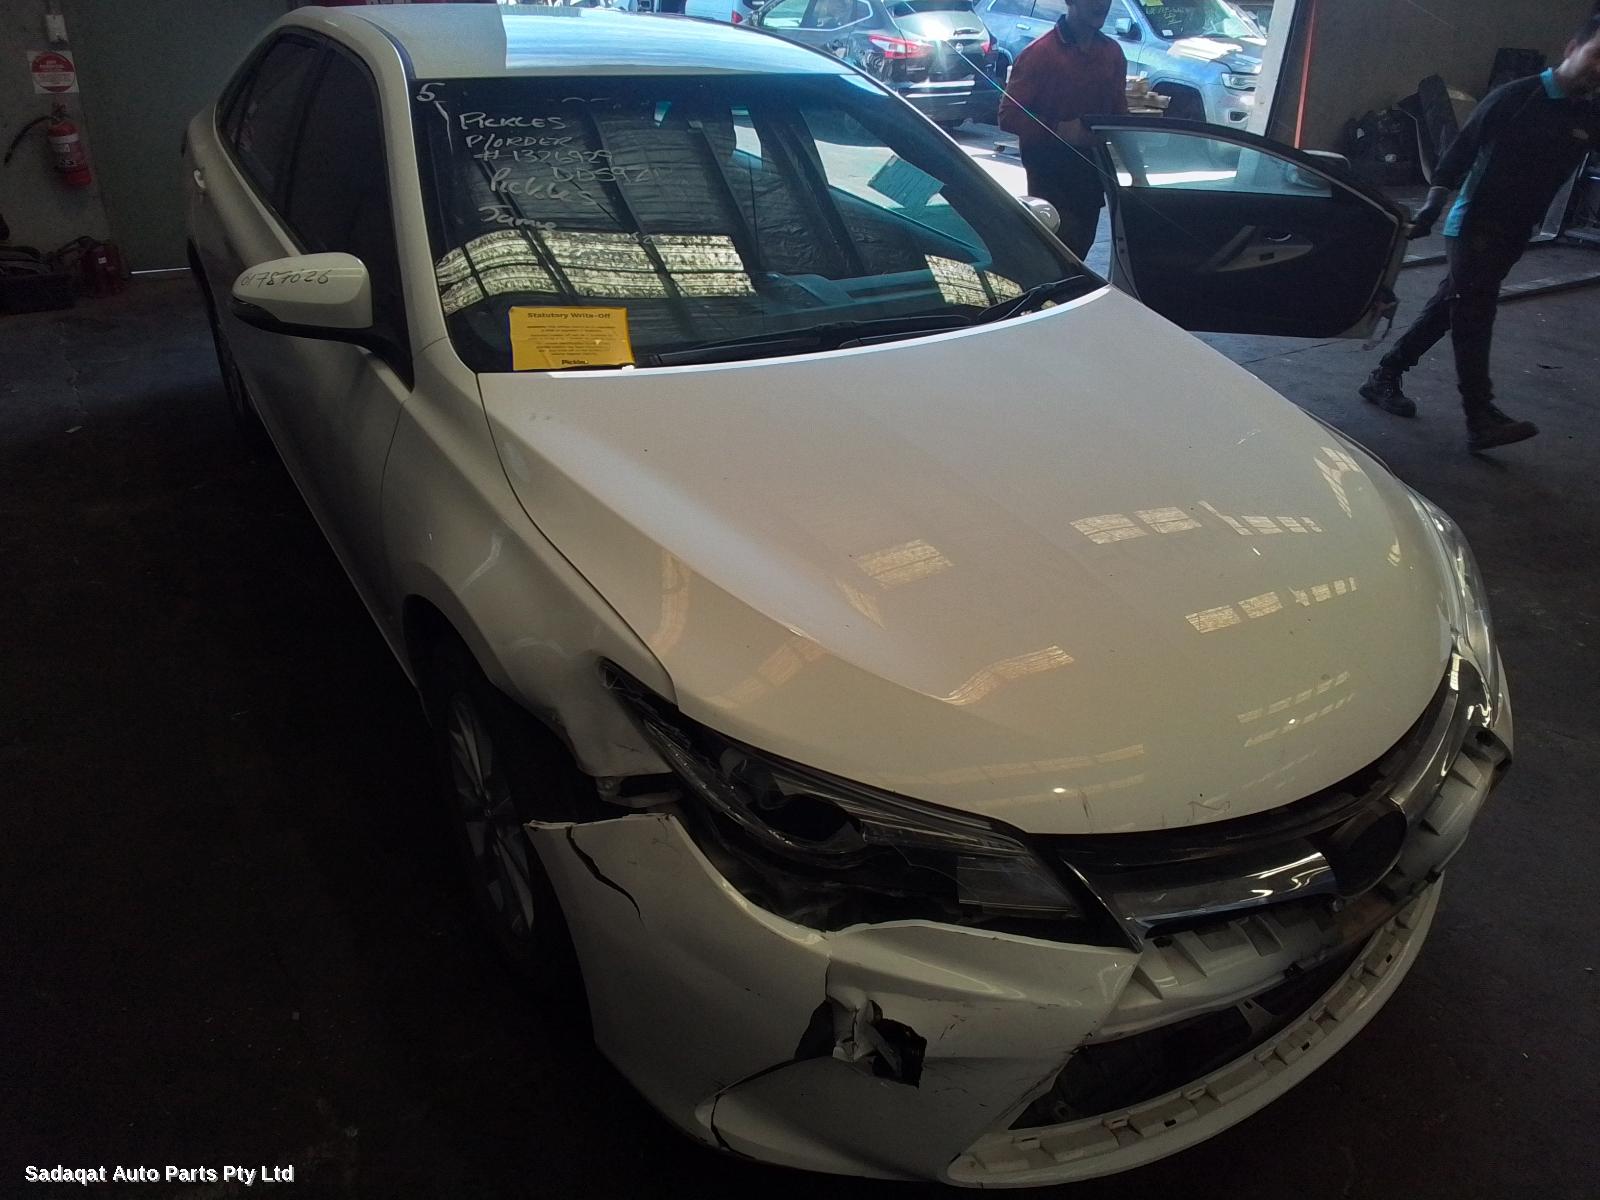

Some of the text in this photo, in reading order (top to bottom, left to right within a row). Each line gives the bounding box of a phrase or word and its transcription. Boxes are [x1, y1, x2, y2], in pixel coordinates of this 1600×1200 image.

[459, 111, 568, 130] PICKLES
[465, 133, 573, 150] P/ORDER
[527, 312, 568, 320] Statutory
